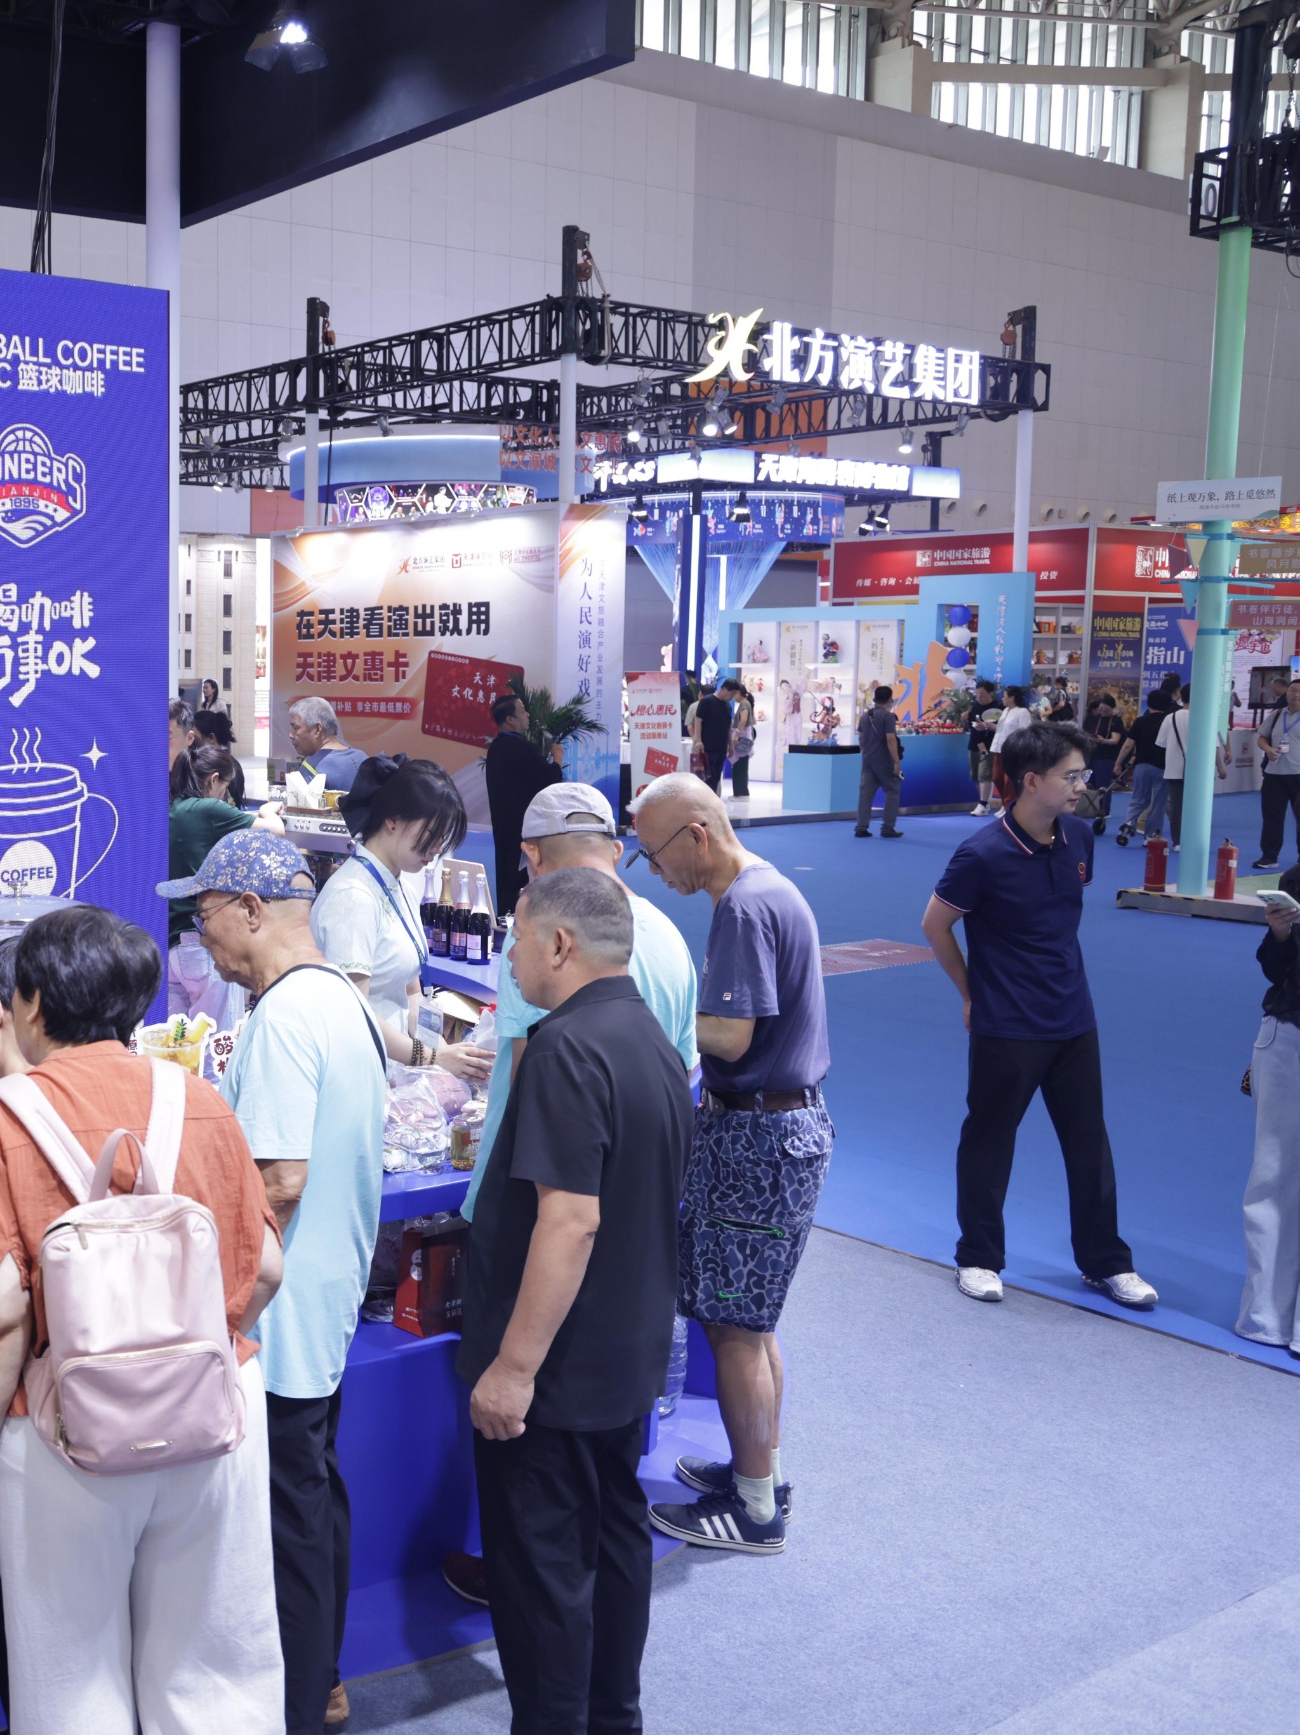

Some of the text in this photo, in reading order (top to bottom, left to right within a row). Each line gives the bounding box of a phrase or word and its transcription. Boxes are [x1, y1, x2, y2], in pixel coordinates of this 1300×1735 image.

[56, 340, 145, 373] COFFEE
[762, 320, 981, 406] 北方演艺集团
[17, 362, 105, 397] 篮球咖啡
[10, 497, 40, 509] 1895
[933, 547, 991, 561] 中国国家旅游
[1039, 570, 1058, 580] 投资
[295, 601, 491, 641] 在天津看演出就用
[577, 557, 594, 698] 为人民演好戏
[1144, 646, 1186, 665] 指山
[295, 650, 411, 684] 天津文惠卡
[473, 671, 496, 687] 天津
[356, 701, 411, 714] 享全市最低票价
[0, 866, 55, 883] COFFEE
